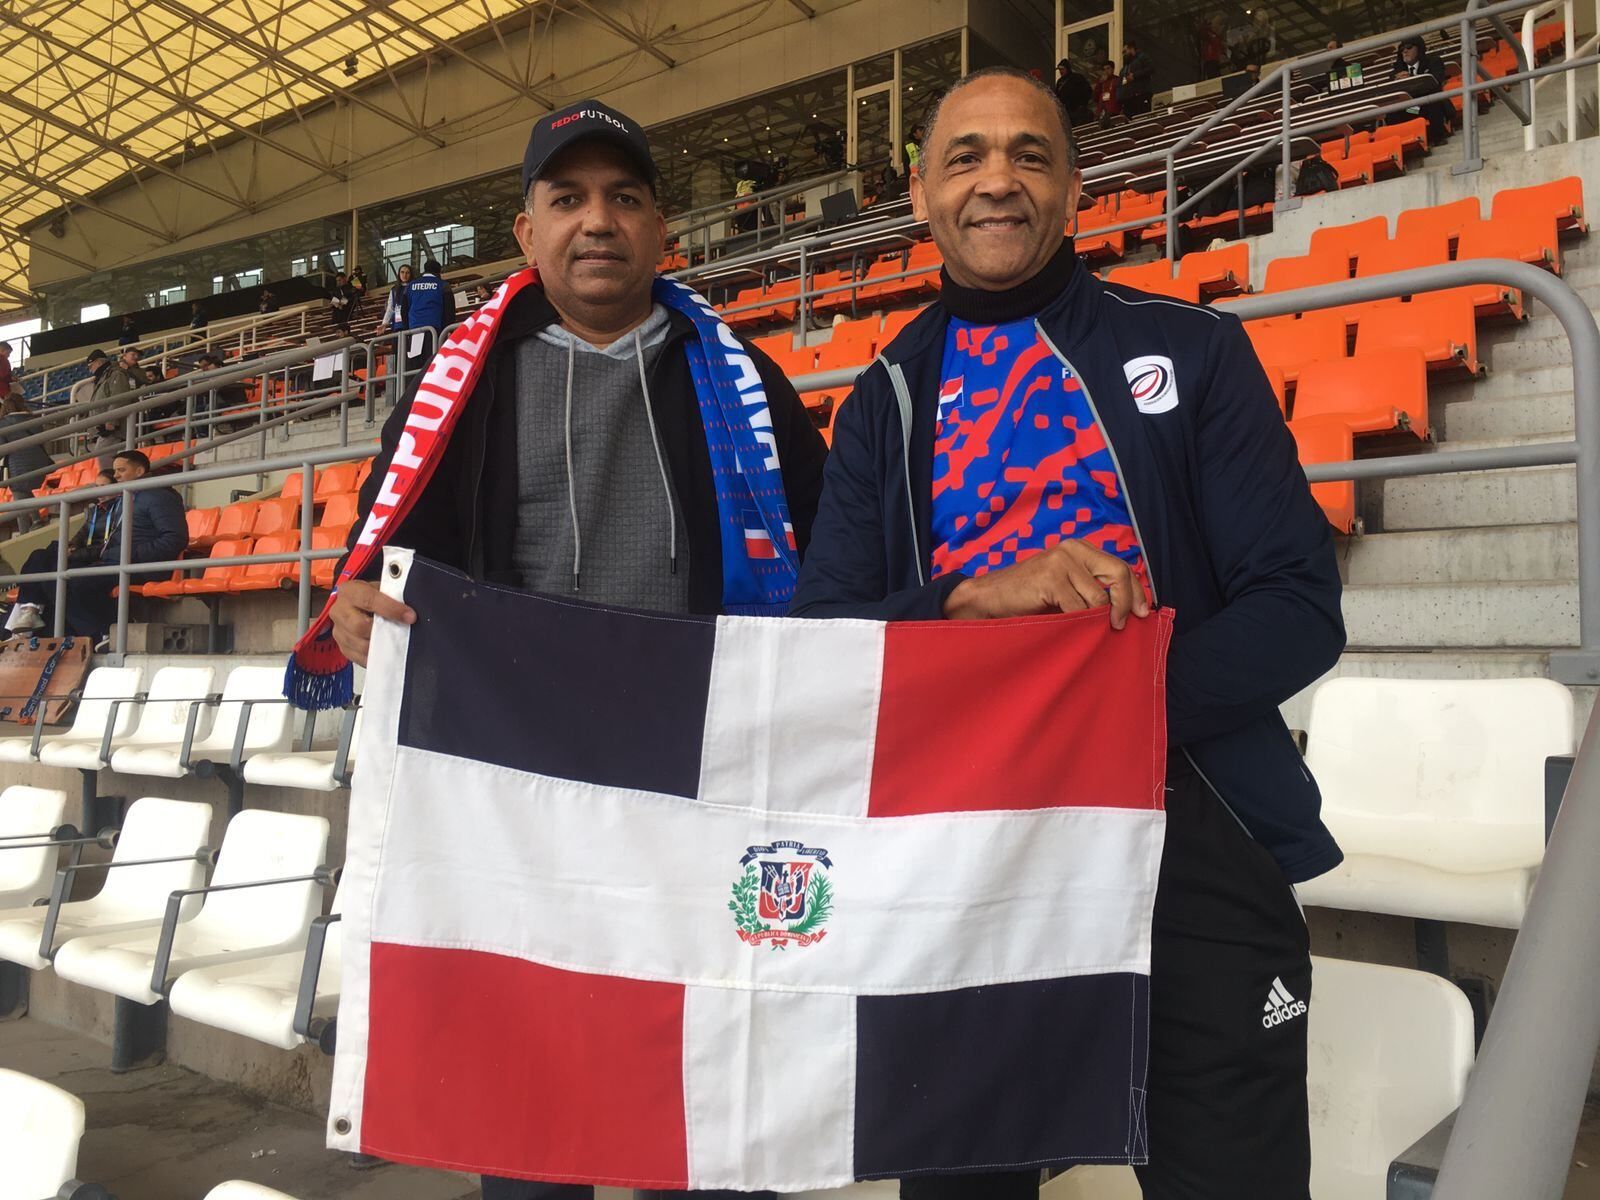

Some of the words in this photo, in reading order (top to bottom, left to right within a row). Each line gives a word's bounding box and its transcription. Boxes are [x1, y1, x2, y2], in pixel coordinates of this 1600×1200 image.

[551, 109, 629, 133] FEDOFUTBOL
[412, 282, 438, 291] UTEDYC
[775, 841, 800, 850] PATRIA
[1262, 1000, 1307, 1029] adidas
